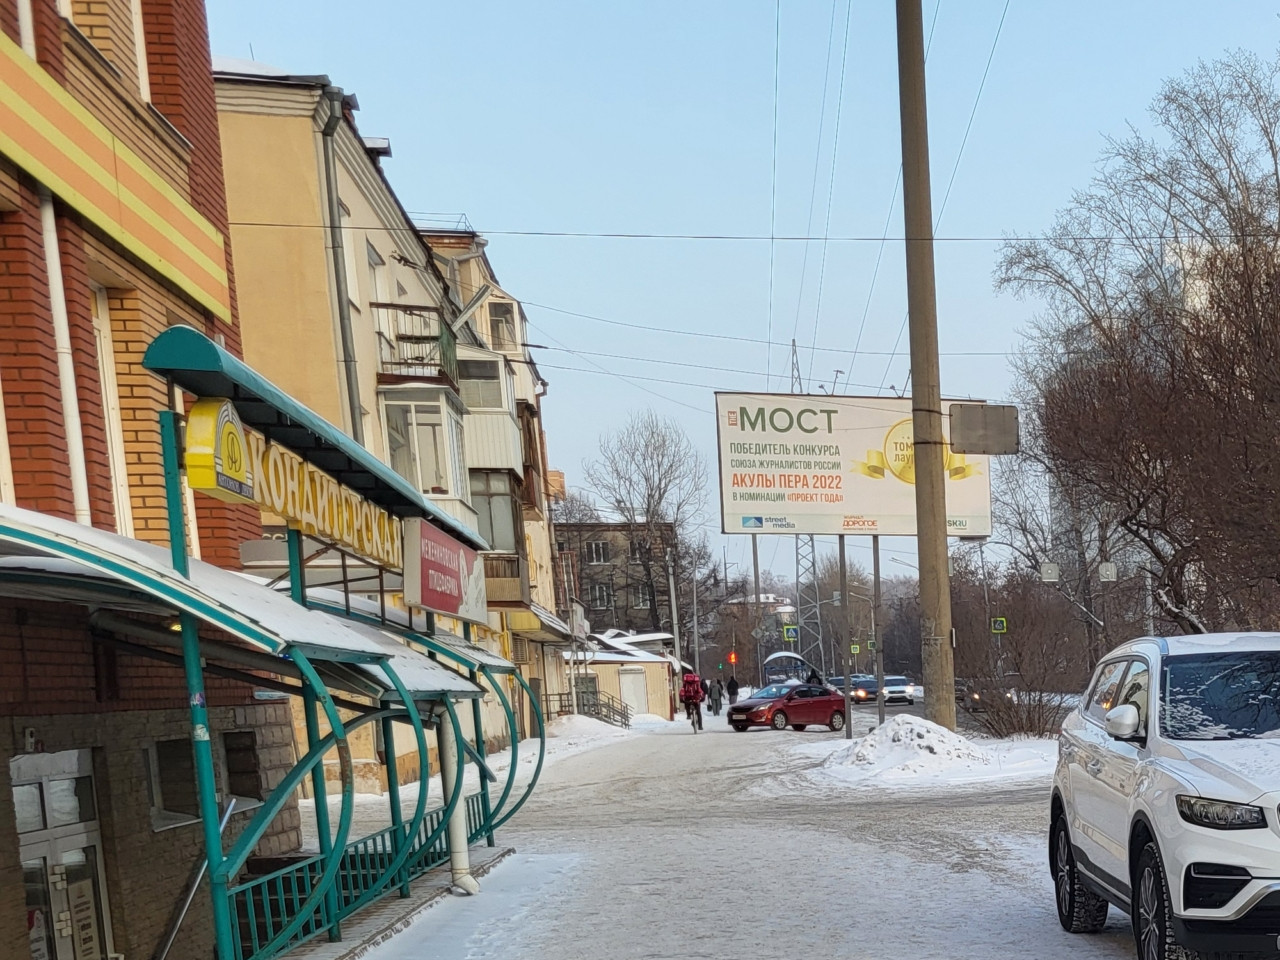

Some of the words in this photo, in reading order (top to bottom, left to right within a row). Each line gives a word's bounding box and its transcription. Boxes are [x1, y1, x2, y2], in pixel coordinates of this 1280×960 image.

[739, 407, 838, 434] МОСТ
[730, 442, 791, 456] ПОБЕДИТЕЛЬ
[793, 444, 841, 457] КОНКУРСА
[730, 459, 757, 469] СОЮЗА
[758, 460, 812, 470] ЖУРНАЛИСТОВ
[814, 461, 842, 471] РОССИИ
[732, 473, 776, 489] АКУЛЫ
[779, 474, 809, 489] ПЕРА
[812, 475, 842, 490] 2022
[249, 434, 403, 568] КОНДИТЕРСКАЯ
[732, 492, 738, 501] В
[739, 492, 786, 503] НОМИНАЦИИ
[787, 493, 818, 503] «ПРОЕКТ
[820, 493, 844, 503] ГОДА»
[947, 520, 968, 528] SKRU
